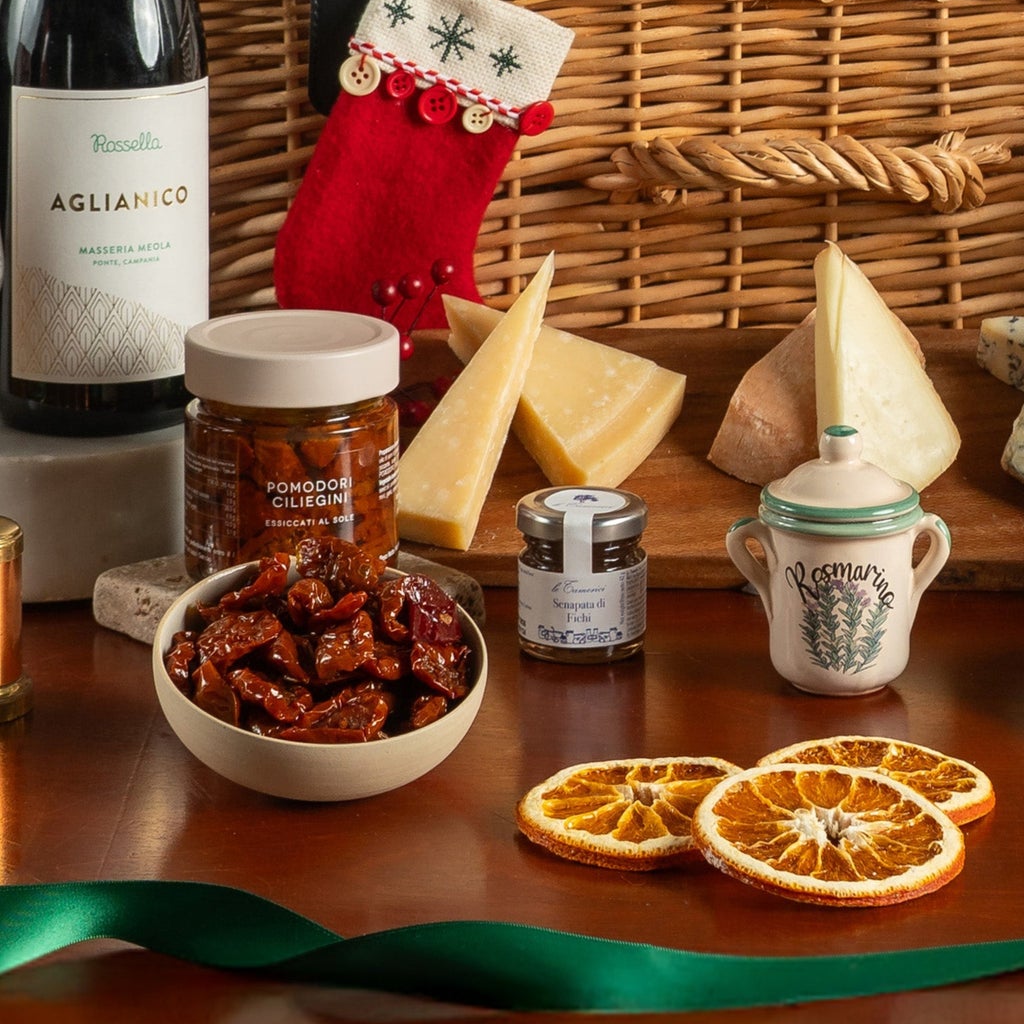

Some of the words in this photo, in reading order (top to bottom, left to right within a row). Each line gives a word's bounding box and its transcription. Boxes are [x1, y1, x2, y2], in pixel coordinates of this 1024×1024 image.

[90, 132, 162, 153] Rossella
[50, 185, 188, 212] AGLIANICO
[78, 245, 134, 255] MASSERIA
[138, 242, 171, 253] MEOLA
[92, 258, 121, 268] PONTE,
[123, 256, 160, 266] CAMPANIA
[267, 477, 353, 494] POMODORI
[272, 492, 348, 508] CILIEGINI
[265, 519, 316, 527] ESSICCATI
[318, 518, 330, 526] AL
[332, 514, 355, 524] SOLE
[785, 561, 894, 610] Rosmarino
[596, 598, 606, 608] di
[567, 613, 591, 622] Fichi
